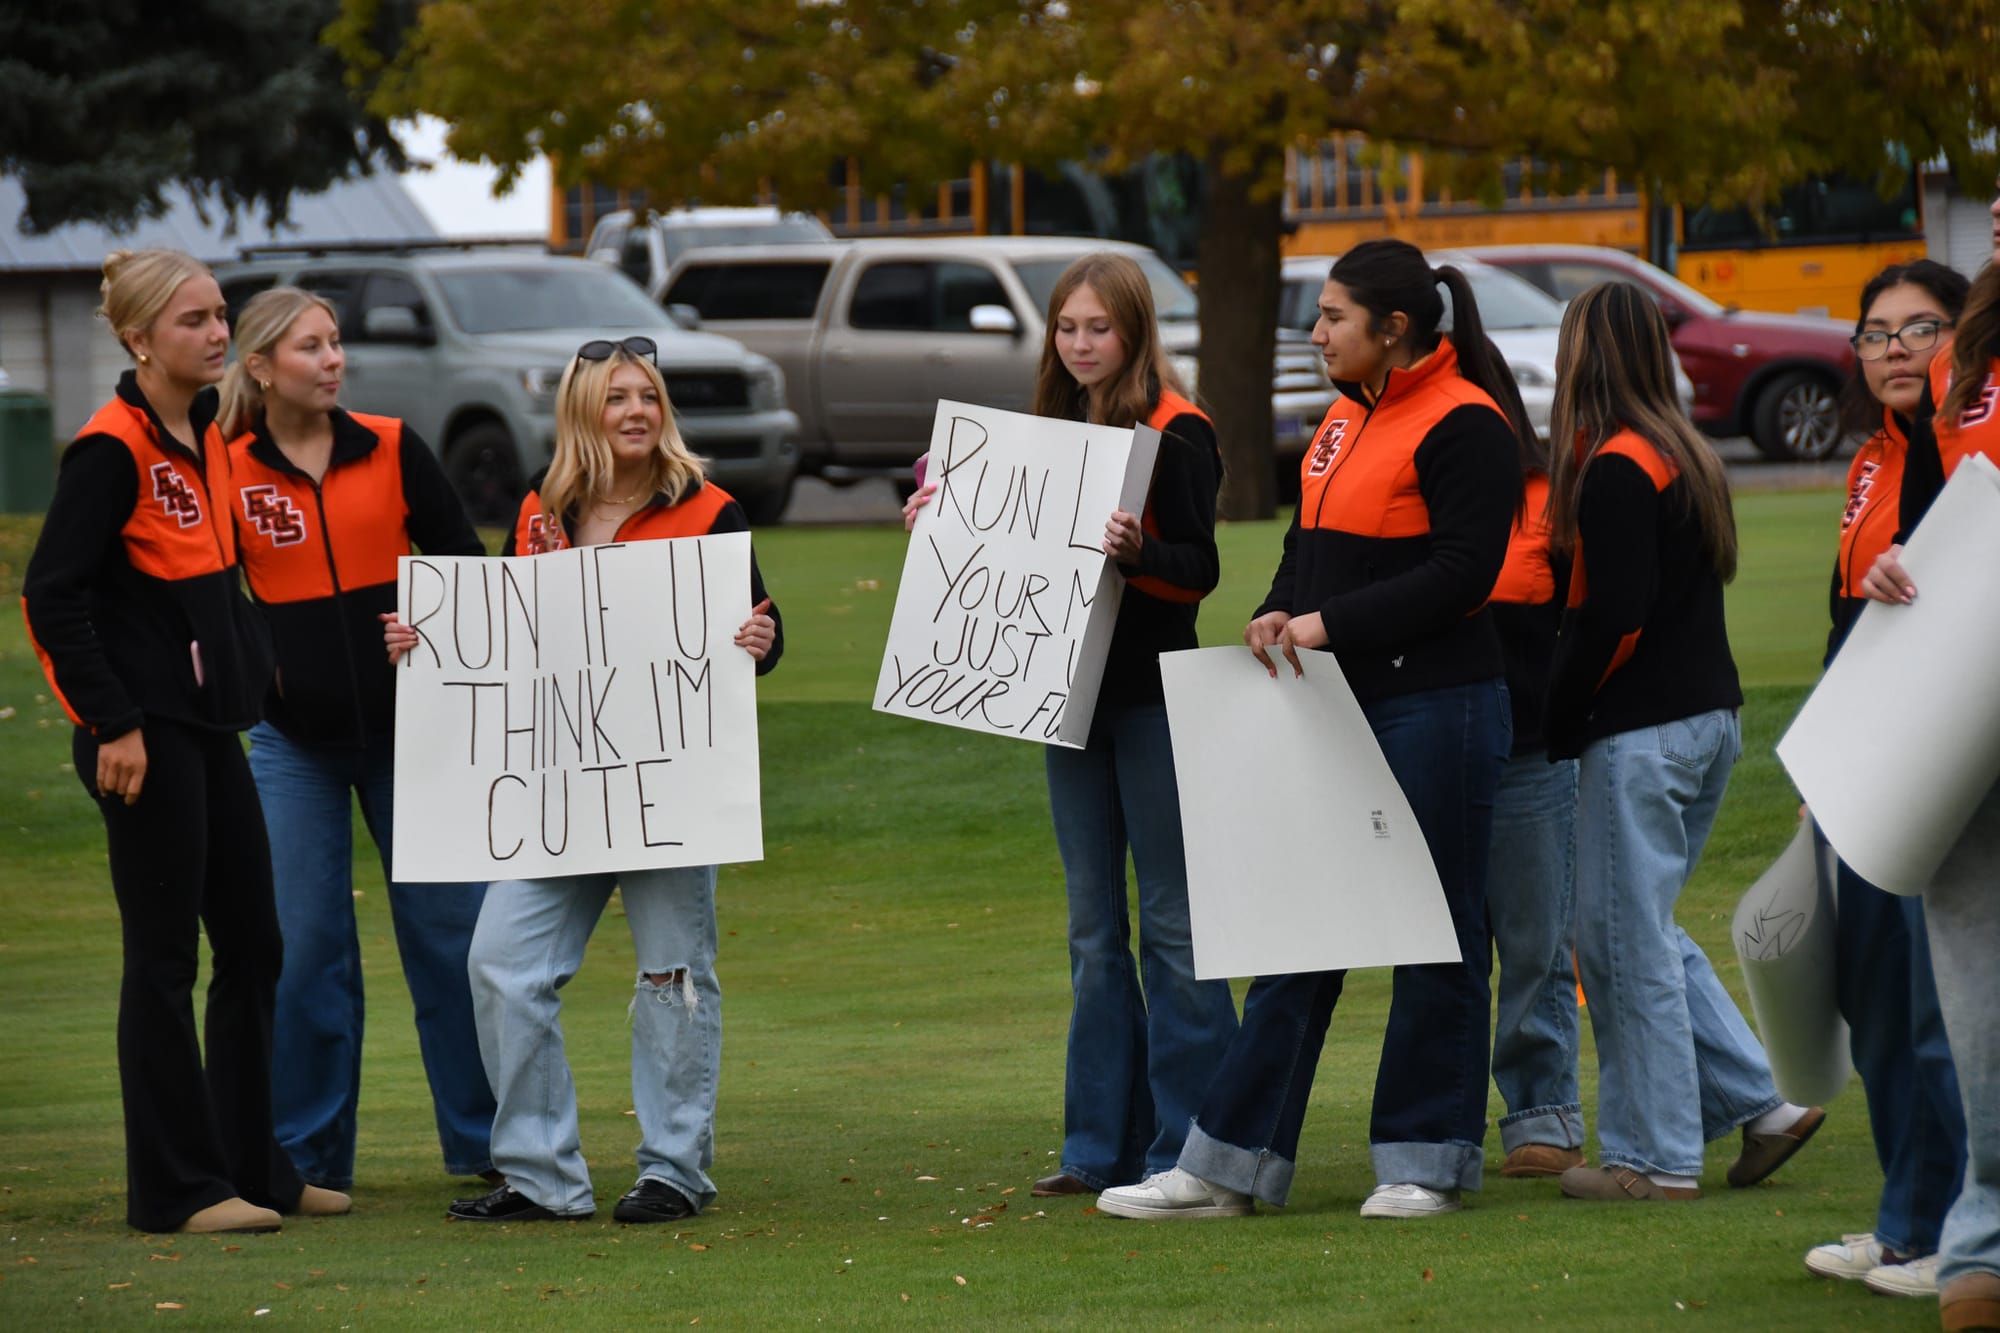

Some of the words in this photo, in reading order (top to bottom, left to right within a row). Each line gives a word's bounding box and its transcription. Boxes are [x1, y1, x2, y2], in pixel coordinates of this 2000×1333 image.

[150, 461, 203, 528] EHS
[240, 484, 307, 547] EHS
[937, 416, 1050, 540] RUN
[407, 559, 539, 671] RUN
[580, 543, 627, 667] IF
[669, 539, 707, 661] U
[929, 534, 1053, 635] YOUR
[883, 654, 1014, 729] YOUR
[933, 613, 1052, 682] JUST
[442, 666, 621, 771] THINK
[650, 657, 712, 752] I'M
[488, 758, 683, 861] CUTE
